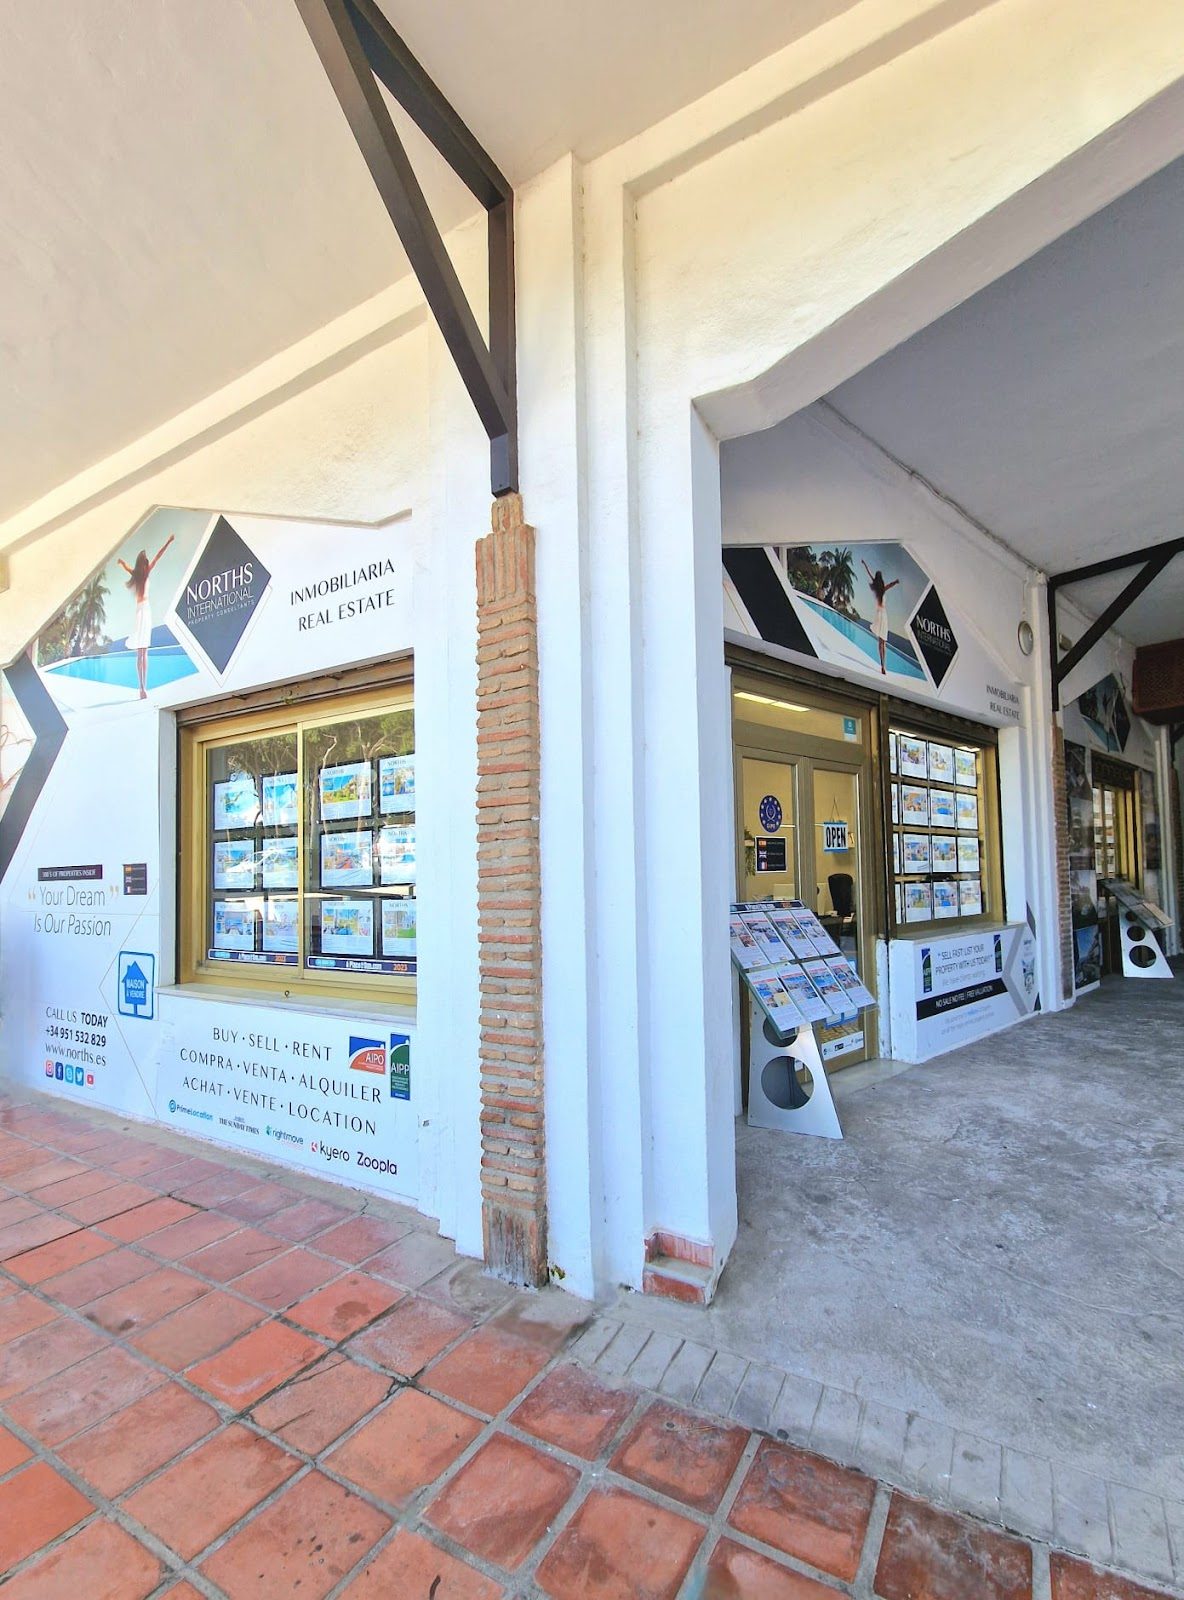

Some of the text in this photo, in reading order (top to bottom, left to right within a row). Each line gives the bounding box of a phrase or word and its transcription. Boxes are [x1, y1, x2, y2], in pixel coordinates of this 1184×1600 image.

[186, 562, 253, 605] NORTHS
[290, 558, 395, 606] INMOBILIARIA
[187, 585, 254, 619] INTERNATIONAL
[298, 588, 396, 632] REAL ESTATE
[916, 614, 951, 643] NORTHS
[825, 826, 847, 848] OPEN
[40, 885, 106, 907] Your Dream
[34, 912, 112, 937] Is Our Passion
[393, 963, 408, 971] 2023
[46, 1006, 108, 1028] CALL US TODAY
[45, 1025, 107, 1048] +34 951 532 829
[213, 1027, 332, 1061] BUY SELL RENT
[45, 1043, 107, 1067] www.norths.es
[365, 1052, 385, 1065] AIPO
[180, 1048, 233, 1071] COMPRA
[243, 1061, 287, 1084] VENTA
[299, 1073, 381, 1104] ALQUILER
[391, 1062, 410, 1075] AIPP
[182, 1076, 376, 1136] ACHAT VENTE LOCATION
[272, 1129, 304, 1145] rightmove
[320, 1140, 350, 1162] kyero
[357, 1151, 398, 1175] Zoopla
